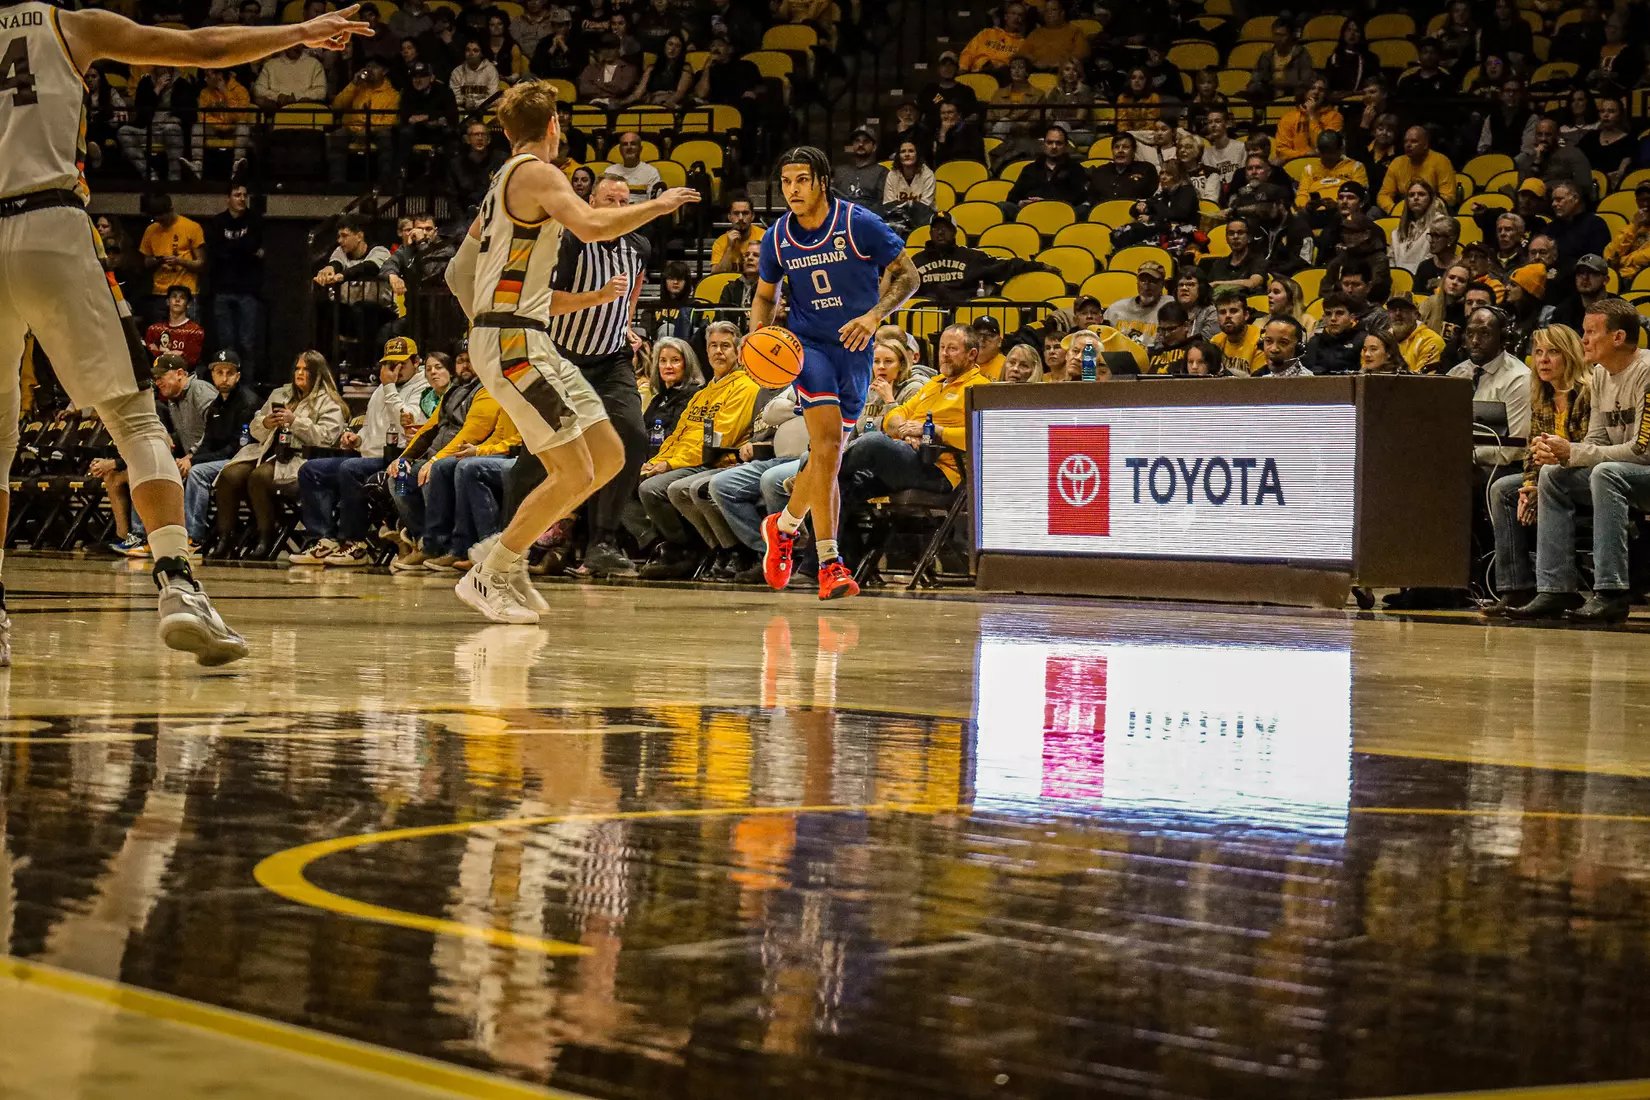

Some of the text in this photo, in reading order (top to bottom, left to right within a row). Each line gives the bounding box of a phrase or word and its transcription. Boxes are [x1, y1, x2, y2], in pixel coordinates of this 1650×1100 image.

[0, 36, 38, 107] 4
[786, 251, 848, 270] LOUISIANA
[917, 259, 967, 275] WYOMING
[811, 269, 832, 294] 0
[922, 271, 964, 283] COWBOYS
[811, 296, 843, 310] TECH
[1126, 456, 1286, 506] TOYOTA
